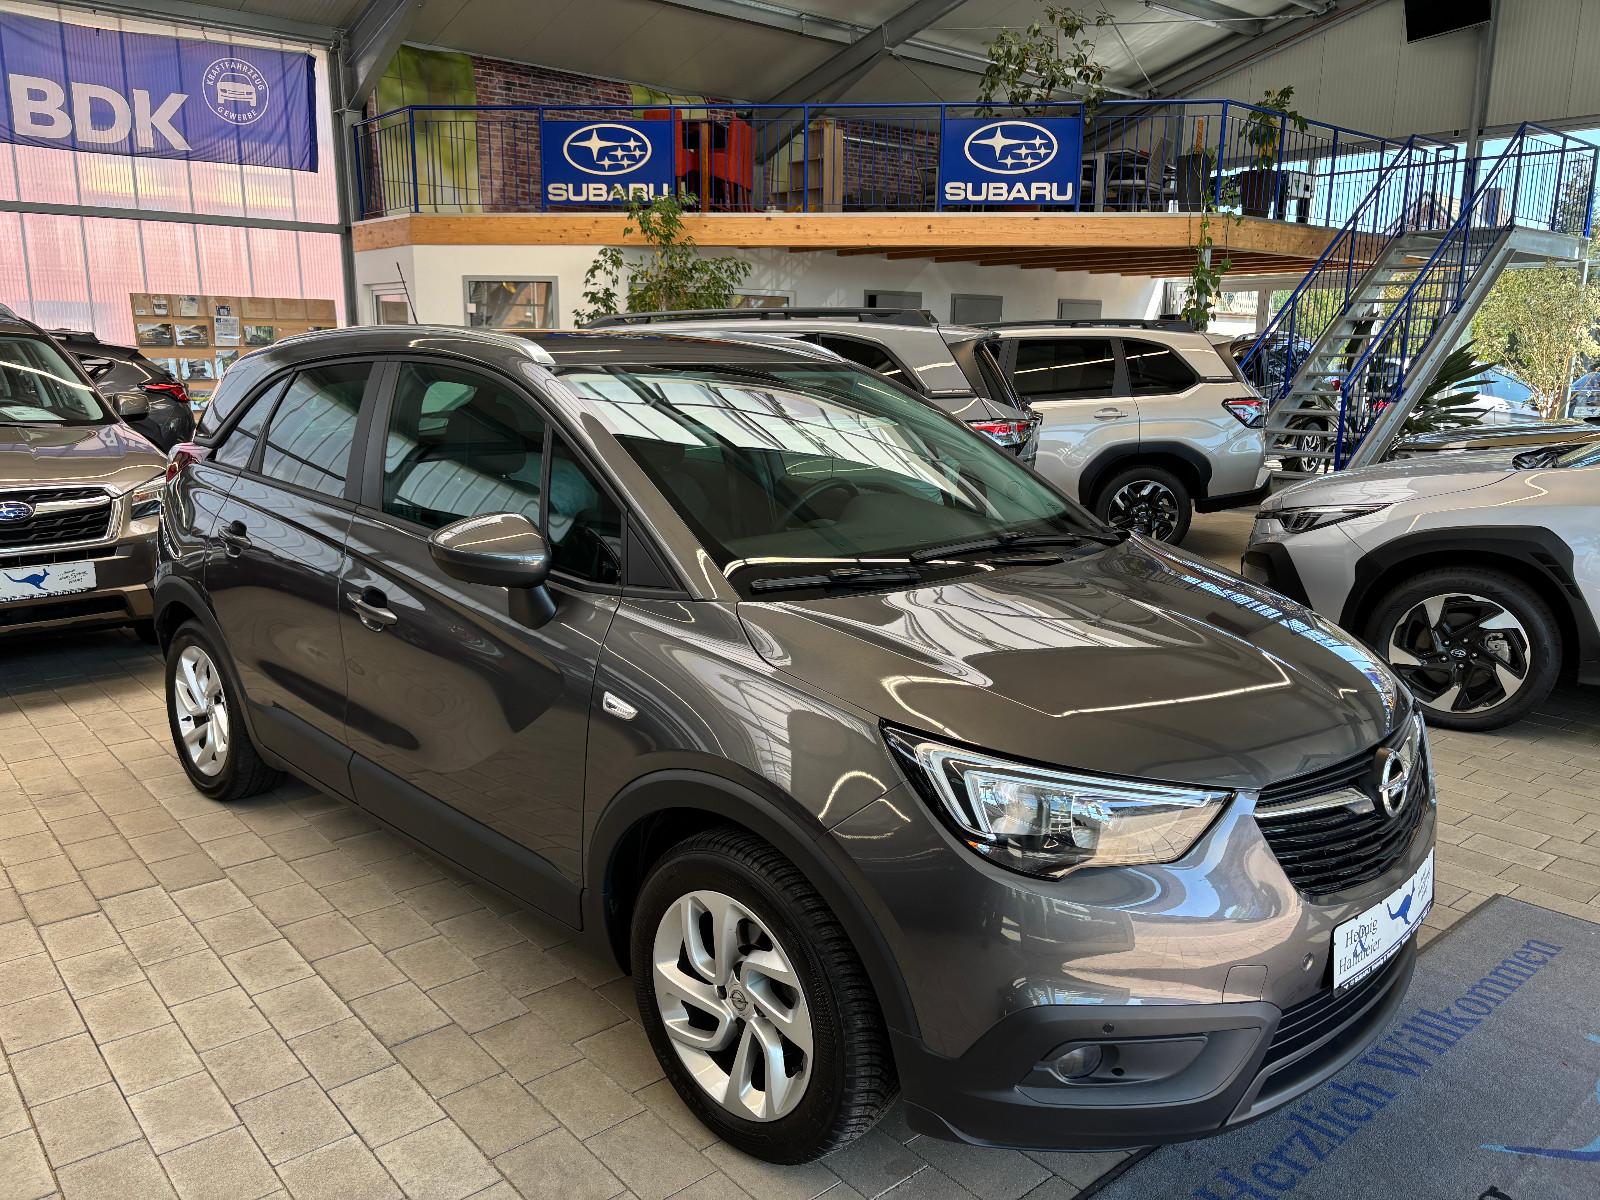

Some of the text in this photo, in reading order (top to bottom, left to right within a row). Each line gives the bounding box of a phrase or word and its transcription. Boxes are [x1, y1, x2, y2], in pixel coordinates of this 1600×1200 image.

[206, 61, 265, 91] KRAFTFAHRZEUG
[9, 73, 192, 151] BDK
[217, 106, 257, 121] GEWERBE
[547, 183, 669, 202] SUBARU
[944, 182, 1073, 201] SUBARU
[1192, 938, 1563, 1200] Herzlich Willkommen
